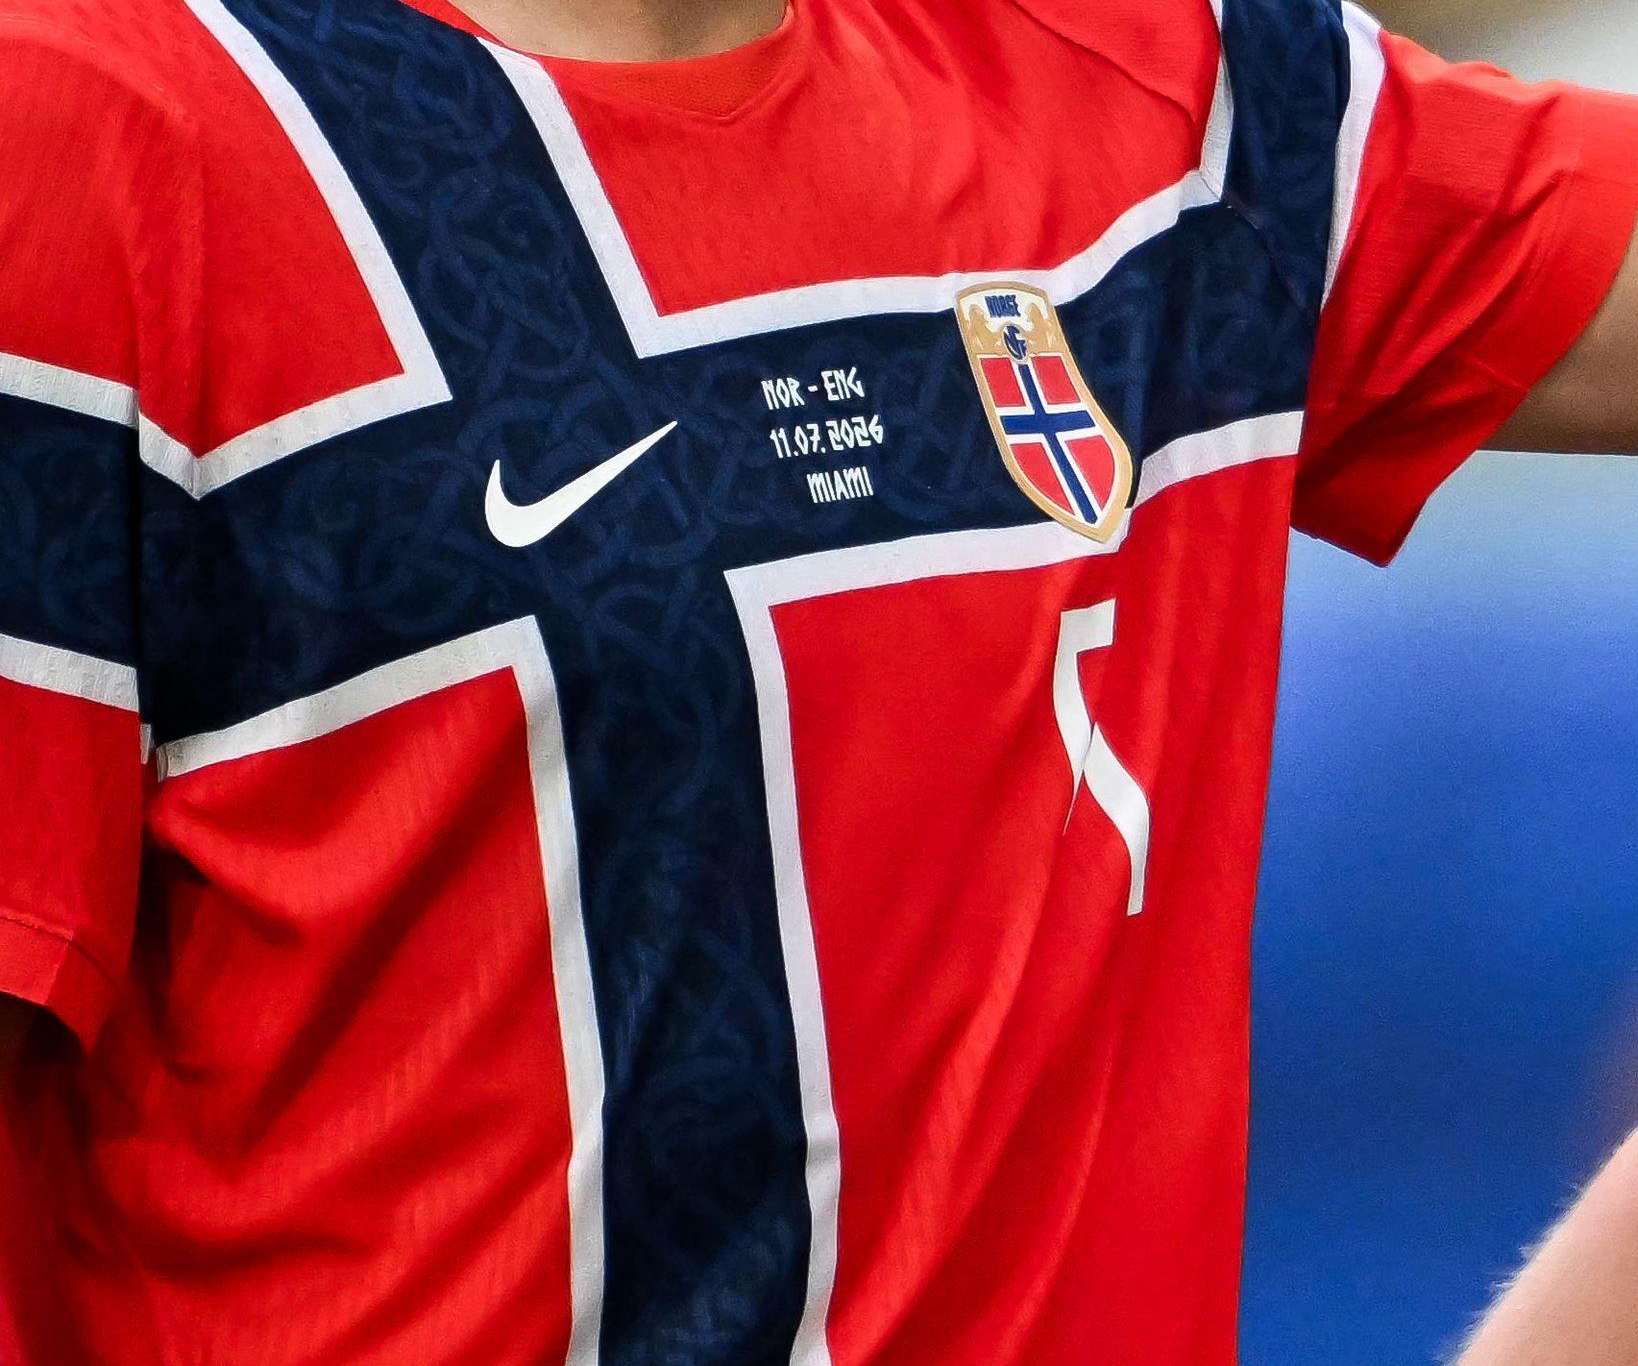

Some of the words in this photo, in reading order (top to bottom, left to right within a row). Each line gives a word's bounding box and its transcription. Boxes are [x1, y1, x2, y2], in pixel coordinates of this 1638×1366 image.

[760, 377, 805, 410] NOR
[821, 366, 865, 401] ENG
[769, 414, 884, 459] 11.07.2026
[806, 466, 874, 504] MIAMI
